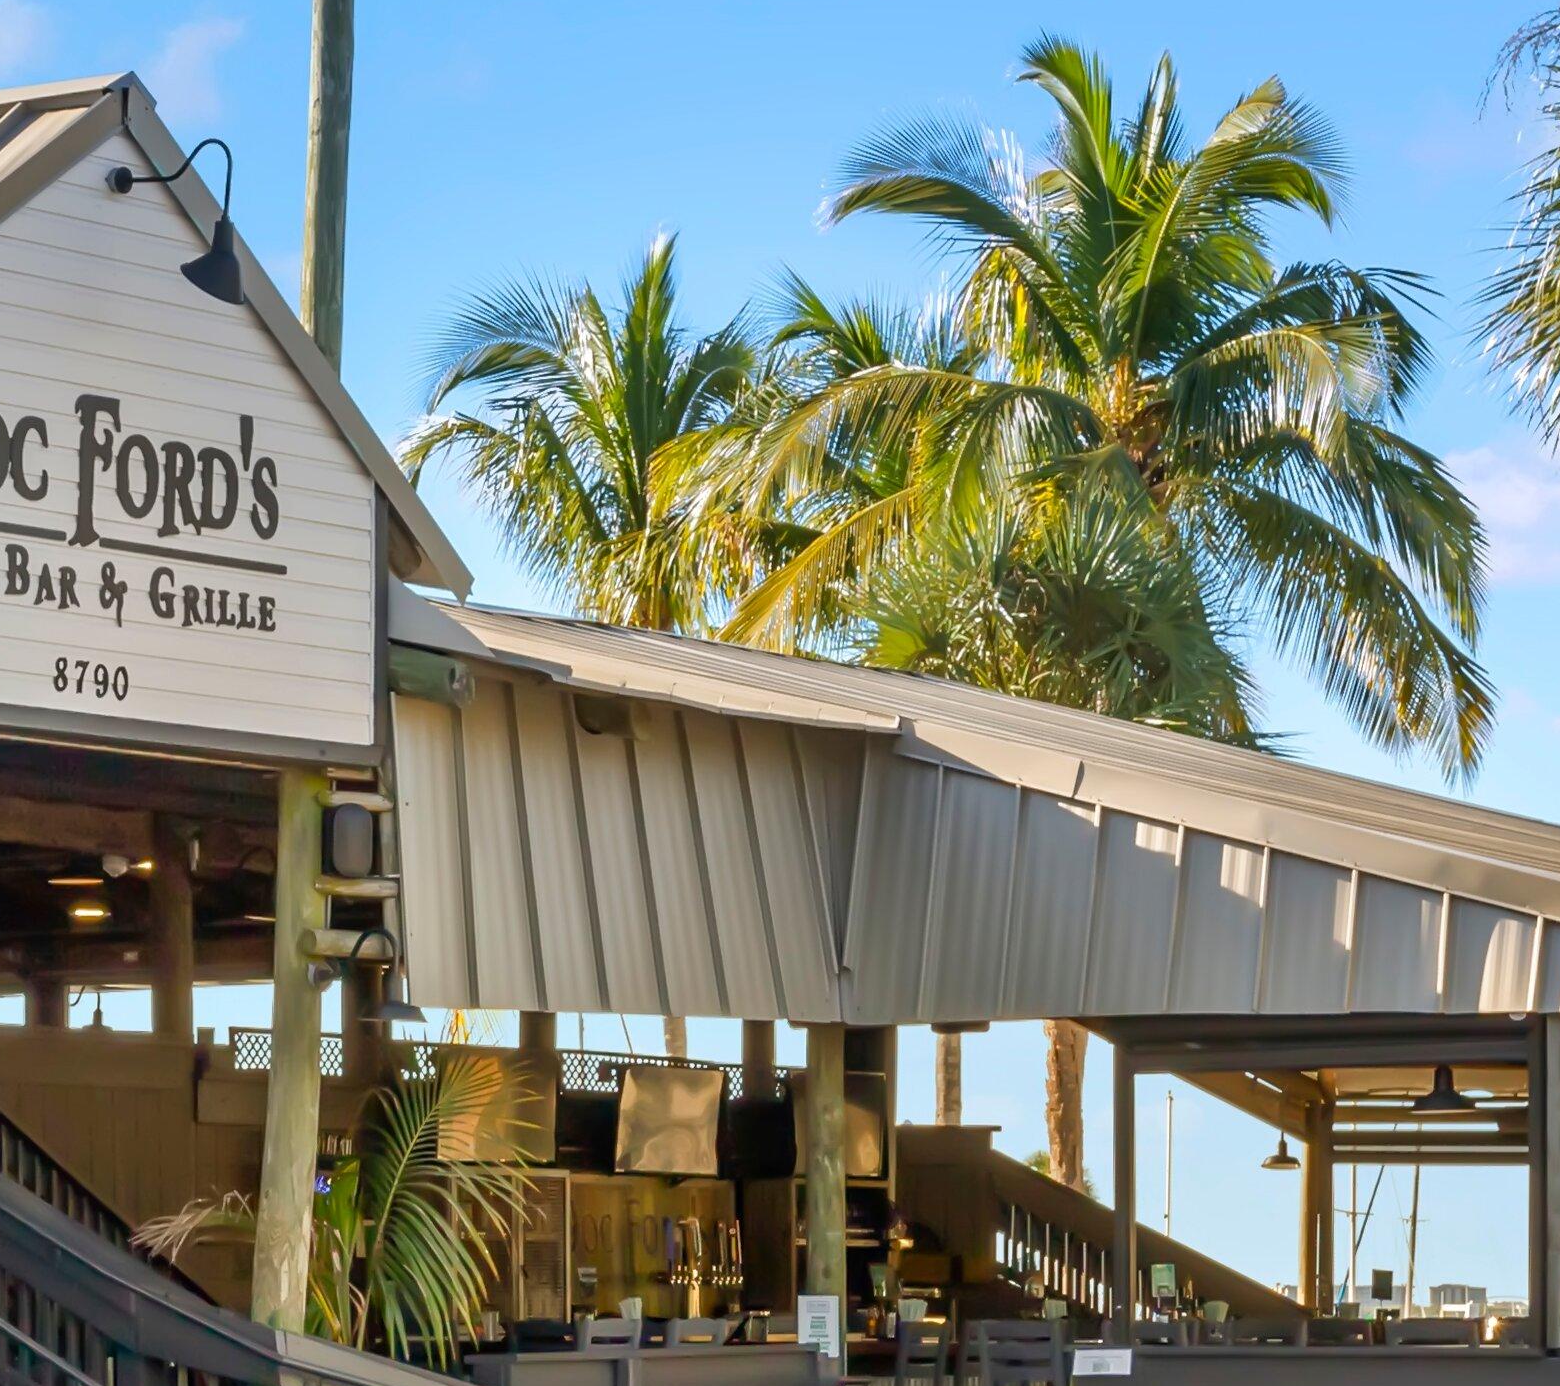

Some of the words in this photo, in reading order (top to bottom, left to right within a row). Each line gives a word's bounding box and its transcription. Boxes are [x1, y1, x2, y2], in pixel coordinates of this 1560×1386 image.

[67, 393, 279, 546] FORD'S
[4, 543, 80, 610] BAR
[98, 560, 128, 627] &
[149, 566, 277, 632] GRILLE
[53, 656, 130, 701] 8790
